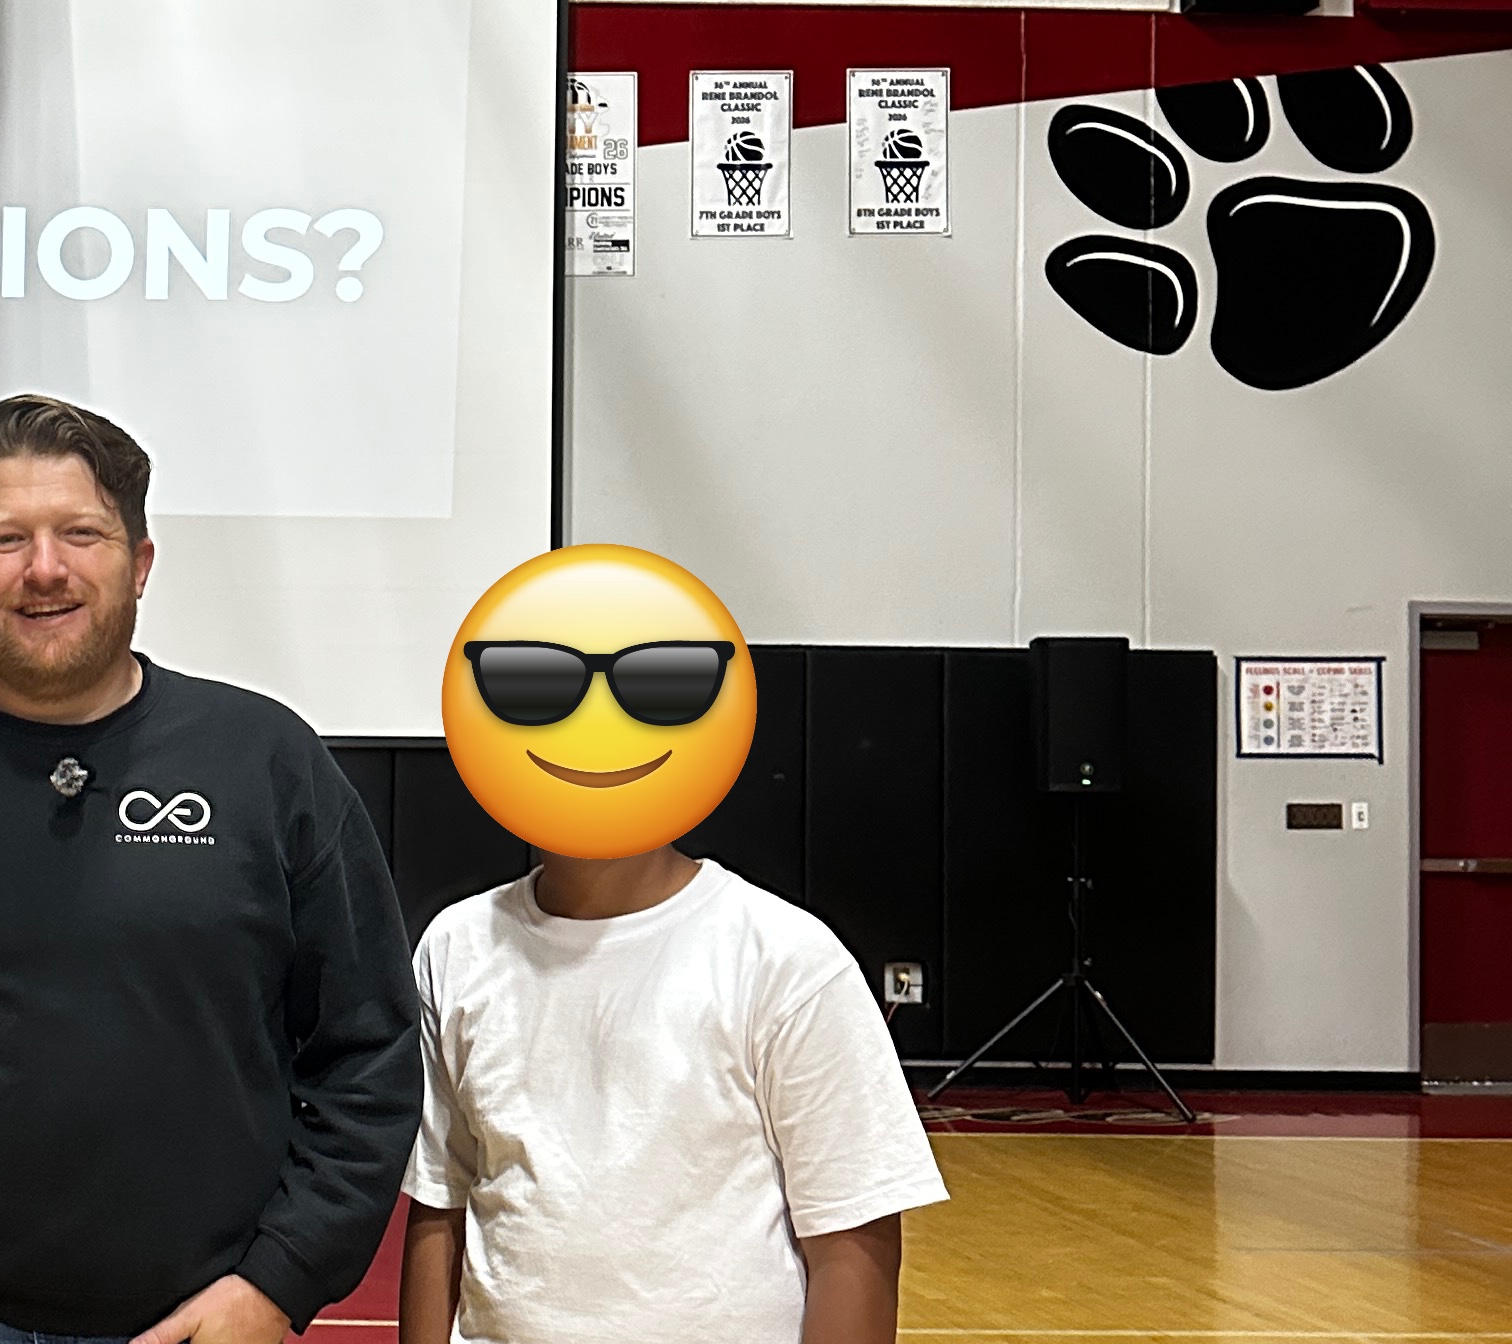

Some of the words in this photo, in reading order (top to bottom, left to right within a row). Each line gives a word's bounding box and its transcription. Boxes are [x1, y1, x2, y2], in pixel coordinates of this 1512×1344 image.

[732, 80, 768, 89] ANNUAL
[889, 77, 925, 86] ANNUAL
[701, 91, 727, 101] RENE
[728, 90, 779, 101] BRANDOL
[858, 88, 884, 97] RENE
[886, 88, 936, 97] BRANDOL
[720, 102, 762, 112] CLASSIC
[878, 99, 919, 109] CLASSIC
[603, 138, 628, 160] 26
[587, 162, 618, 175] BOYS
[699, 210, 717, 220] 7TH
[718, 210, 753, 220] GRADE
[756, 209, 782, 219] BOYS
[877, 207, 912, 217] GRADE
[914, 207, 940, 217] BOYS
[717, 222, 731, 232] 1ST
[733, 222, 765, 232] PLACE
[876, 220, 891, 230] 1ST
[893, 220, 925, 229] PLACE
[115, 834, 215, 845] COMMONGROUND
